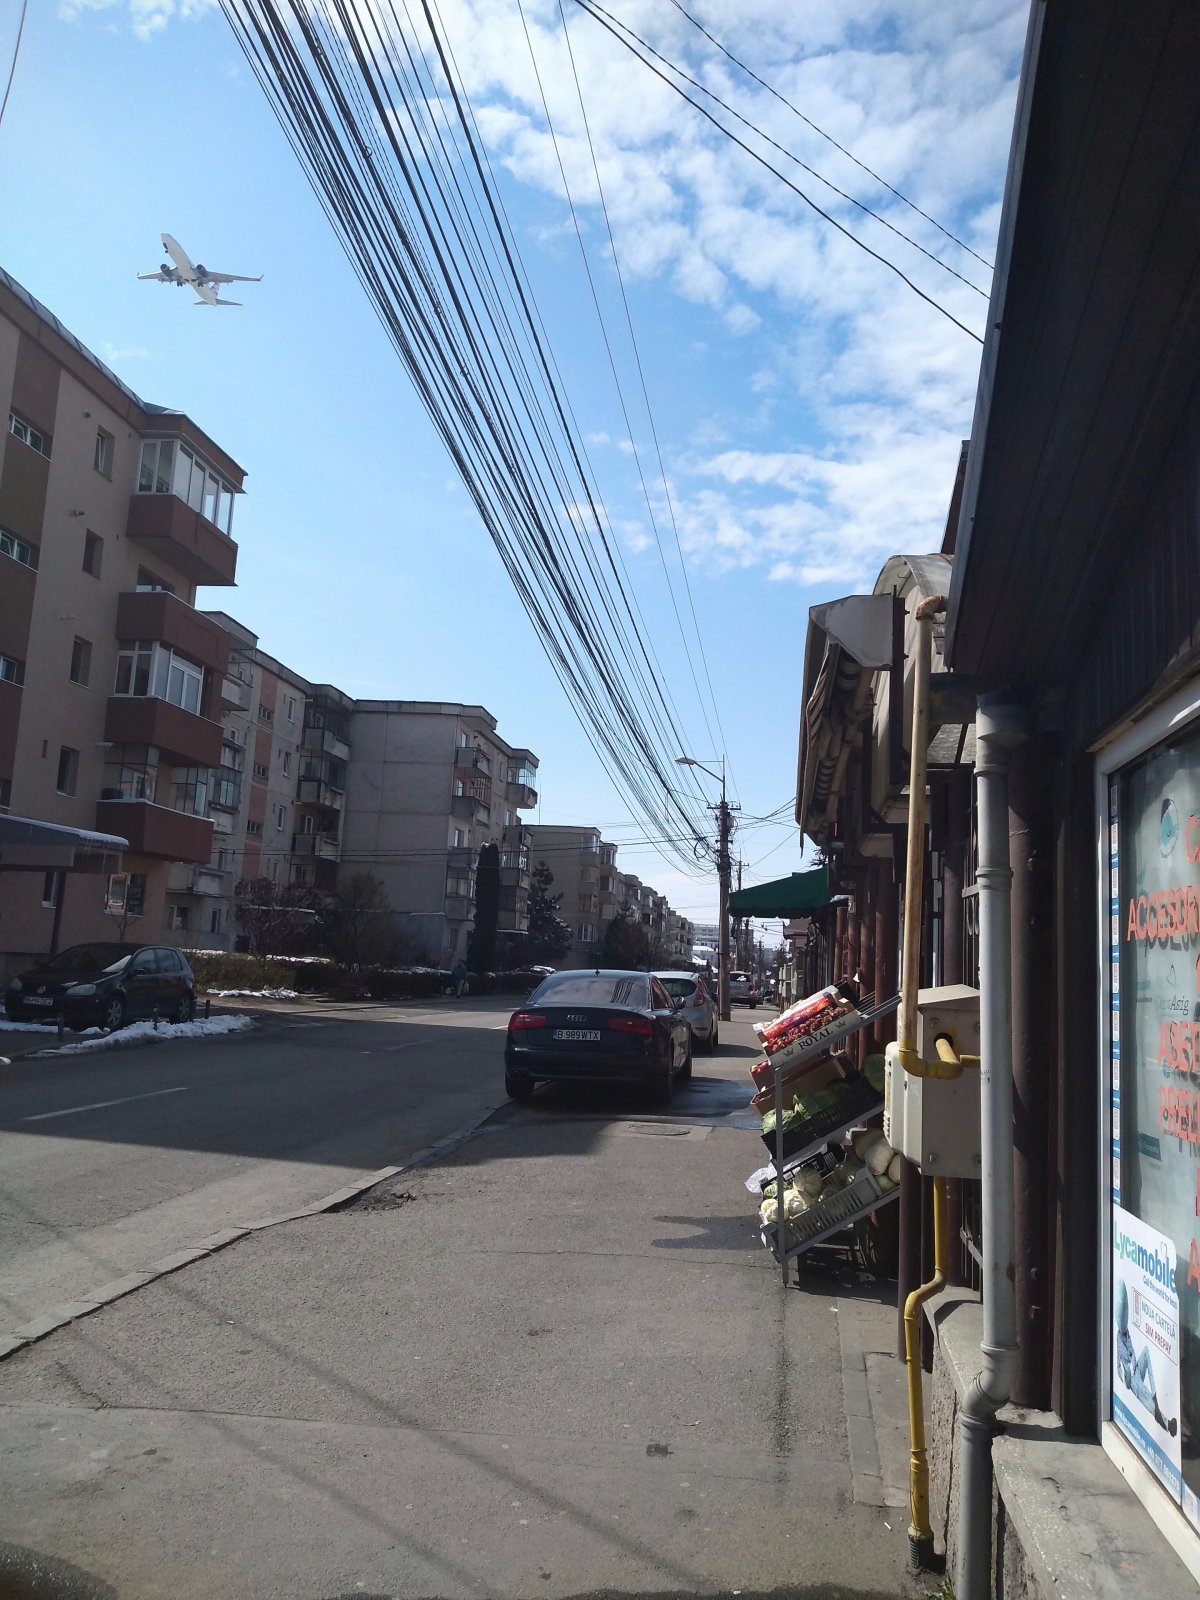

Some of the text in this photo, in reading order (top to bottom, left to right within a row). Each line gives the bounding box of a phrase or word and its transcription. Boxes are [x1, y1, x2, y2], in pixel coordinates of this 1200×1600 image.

[798, 1027, 834, 1050] ROYAL
[1114, 1221, 1177, 1294] Lycamobile
[1145, 1322, 1172, 1355] SIM PREPAY
